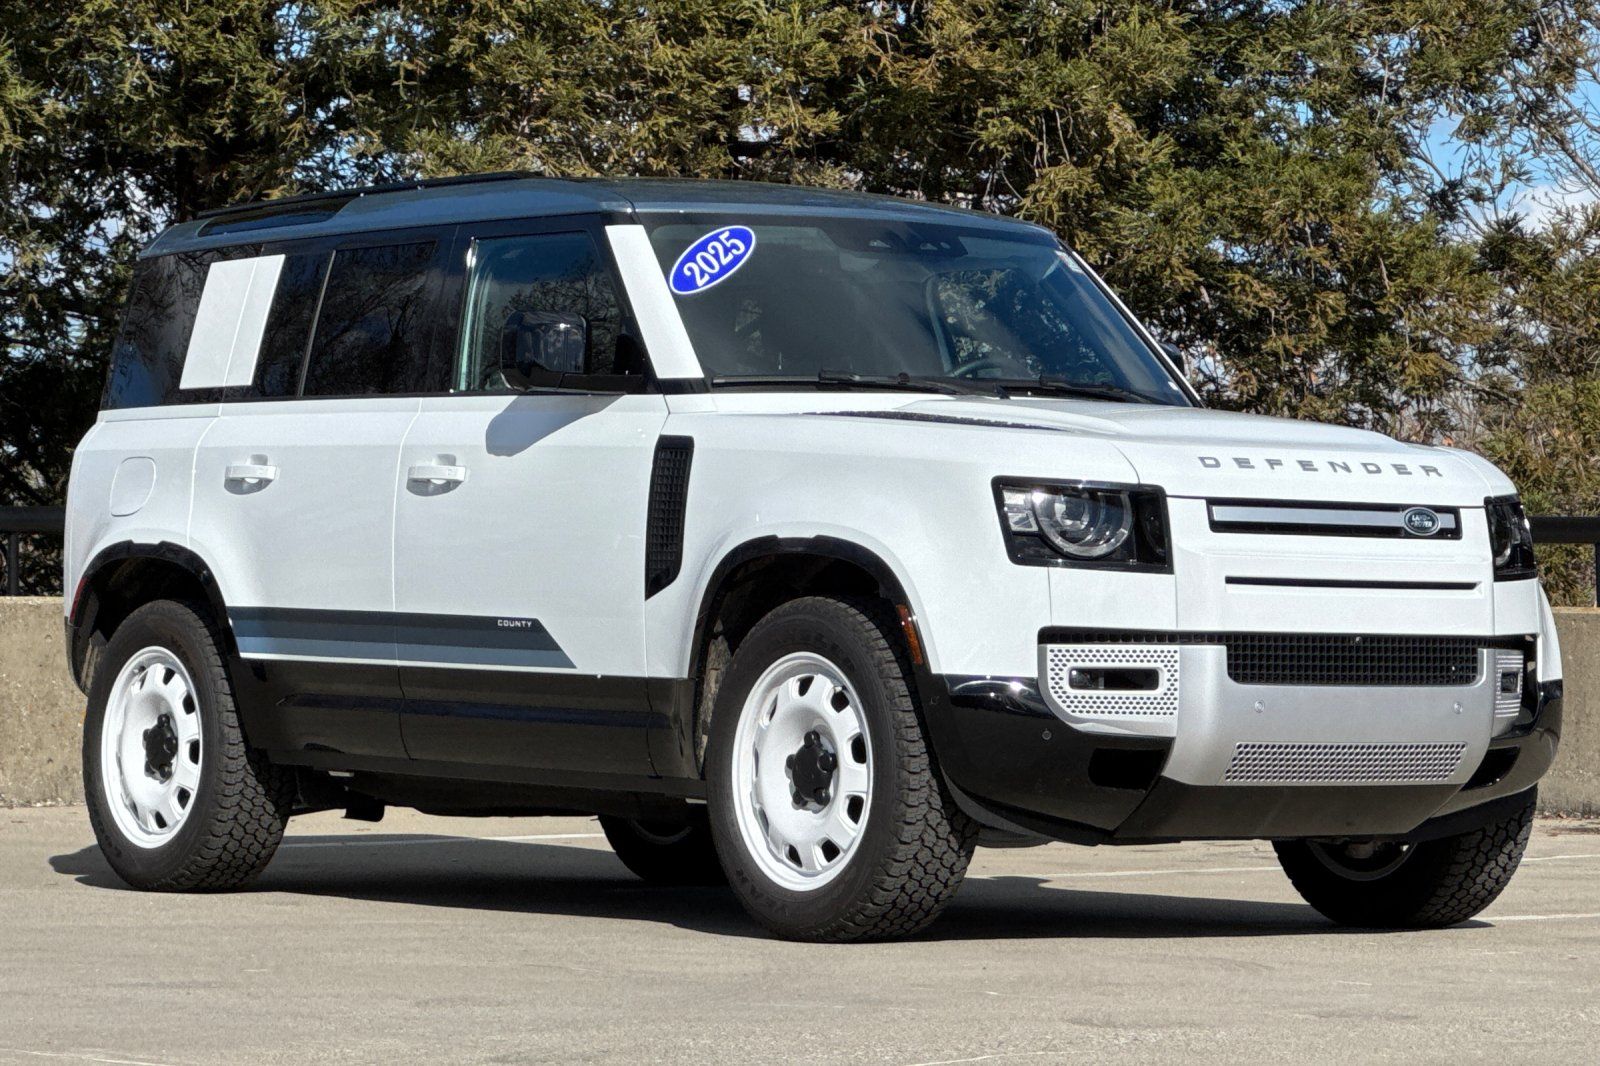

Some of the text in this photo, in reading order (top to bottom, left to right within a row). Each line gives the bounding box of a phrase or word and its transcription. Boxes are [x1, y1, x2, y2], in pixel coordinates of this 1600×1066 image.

[683, 231, 746, 287] 2025
[1198, 456, 1443, 477] DEFENDER
[497, 619, 532, 628] COUNTY
